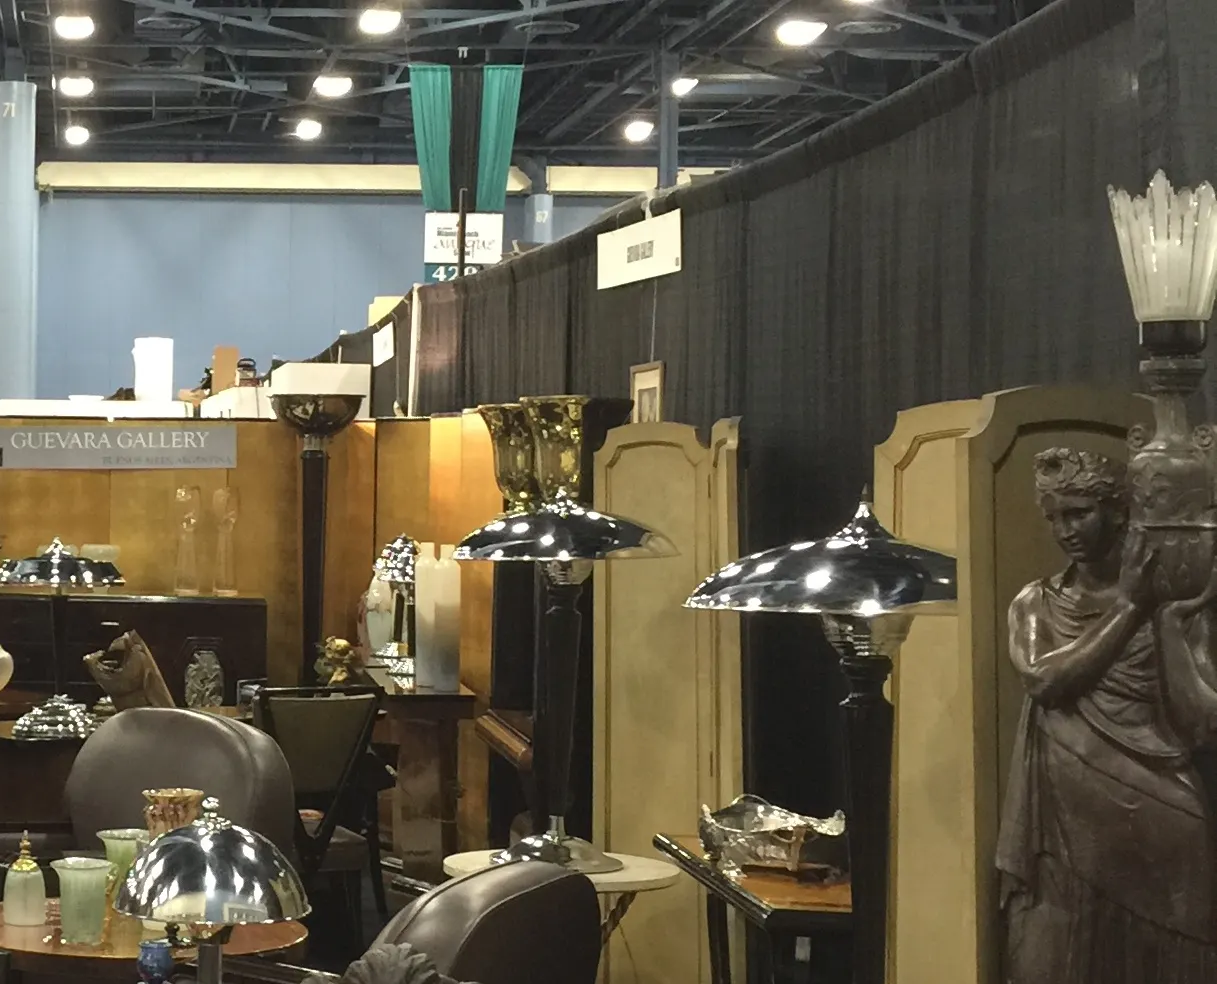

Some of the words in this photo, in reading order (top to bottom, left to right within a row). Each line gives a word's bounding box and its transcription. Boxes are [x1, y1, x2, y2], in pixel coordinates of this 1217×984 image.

[3, 102, 15, 118] 71
[10, 431, 112, 450] GUEVARA
[117, 430, 209, 449] GALLERY
